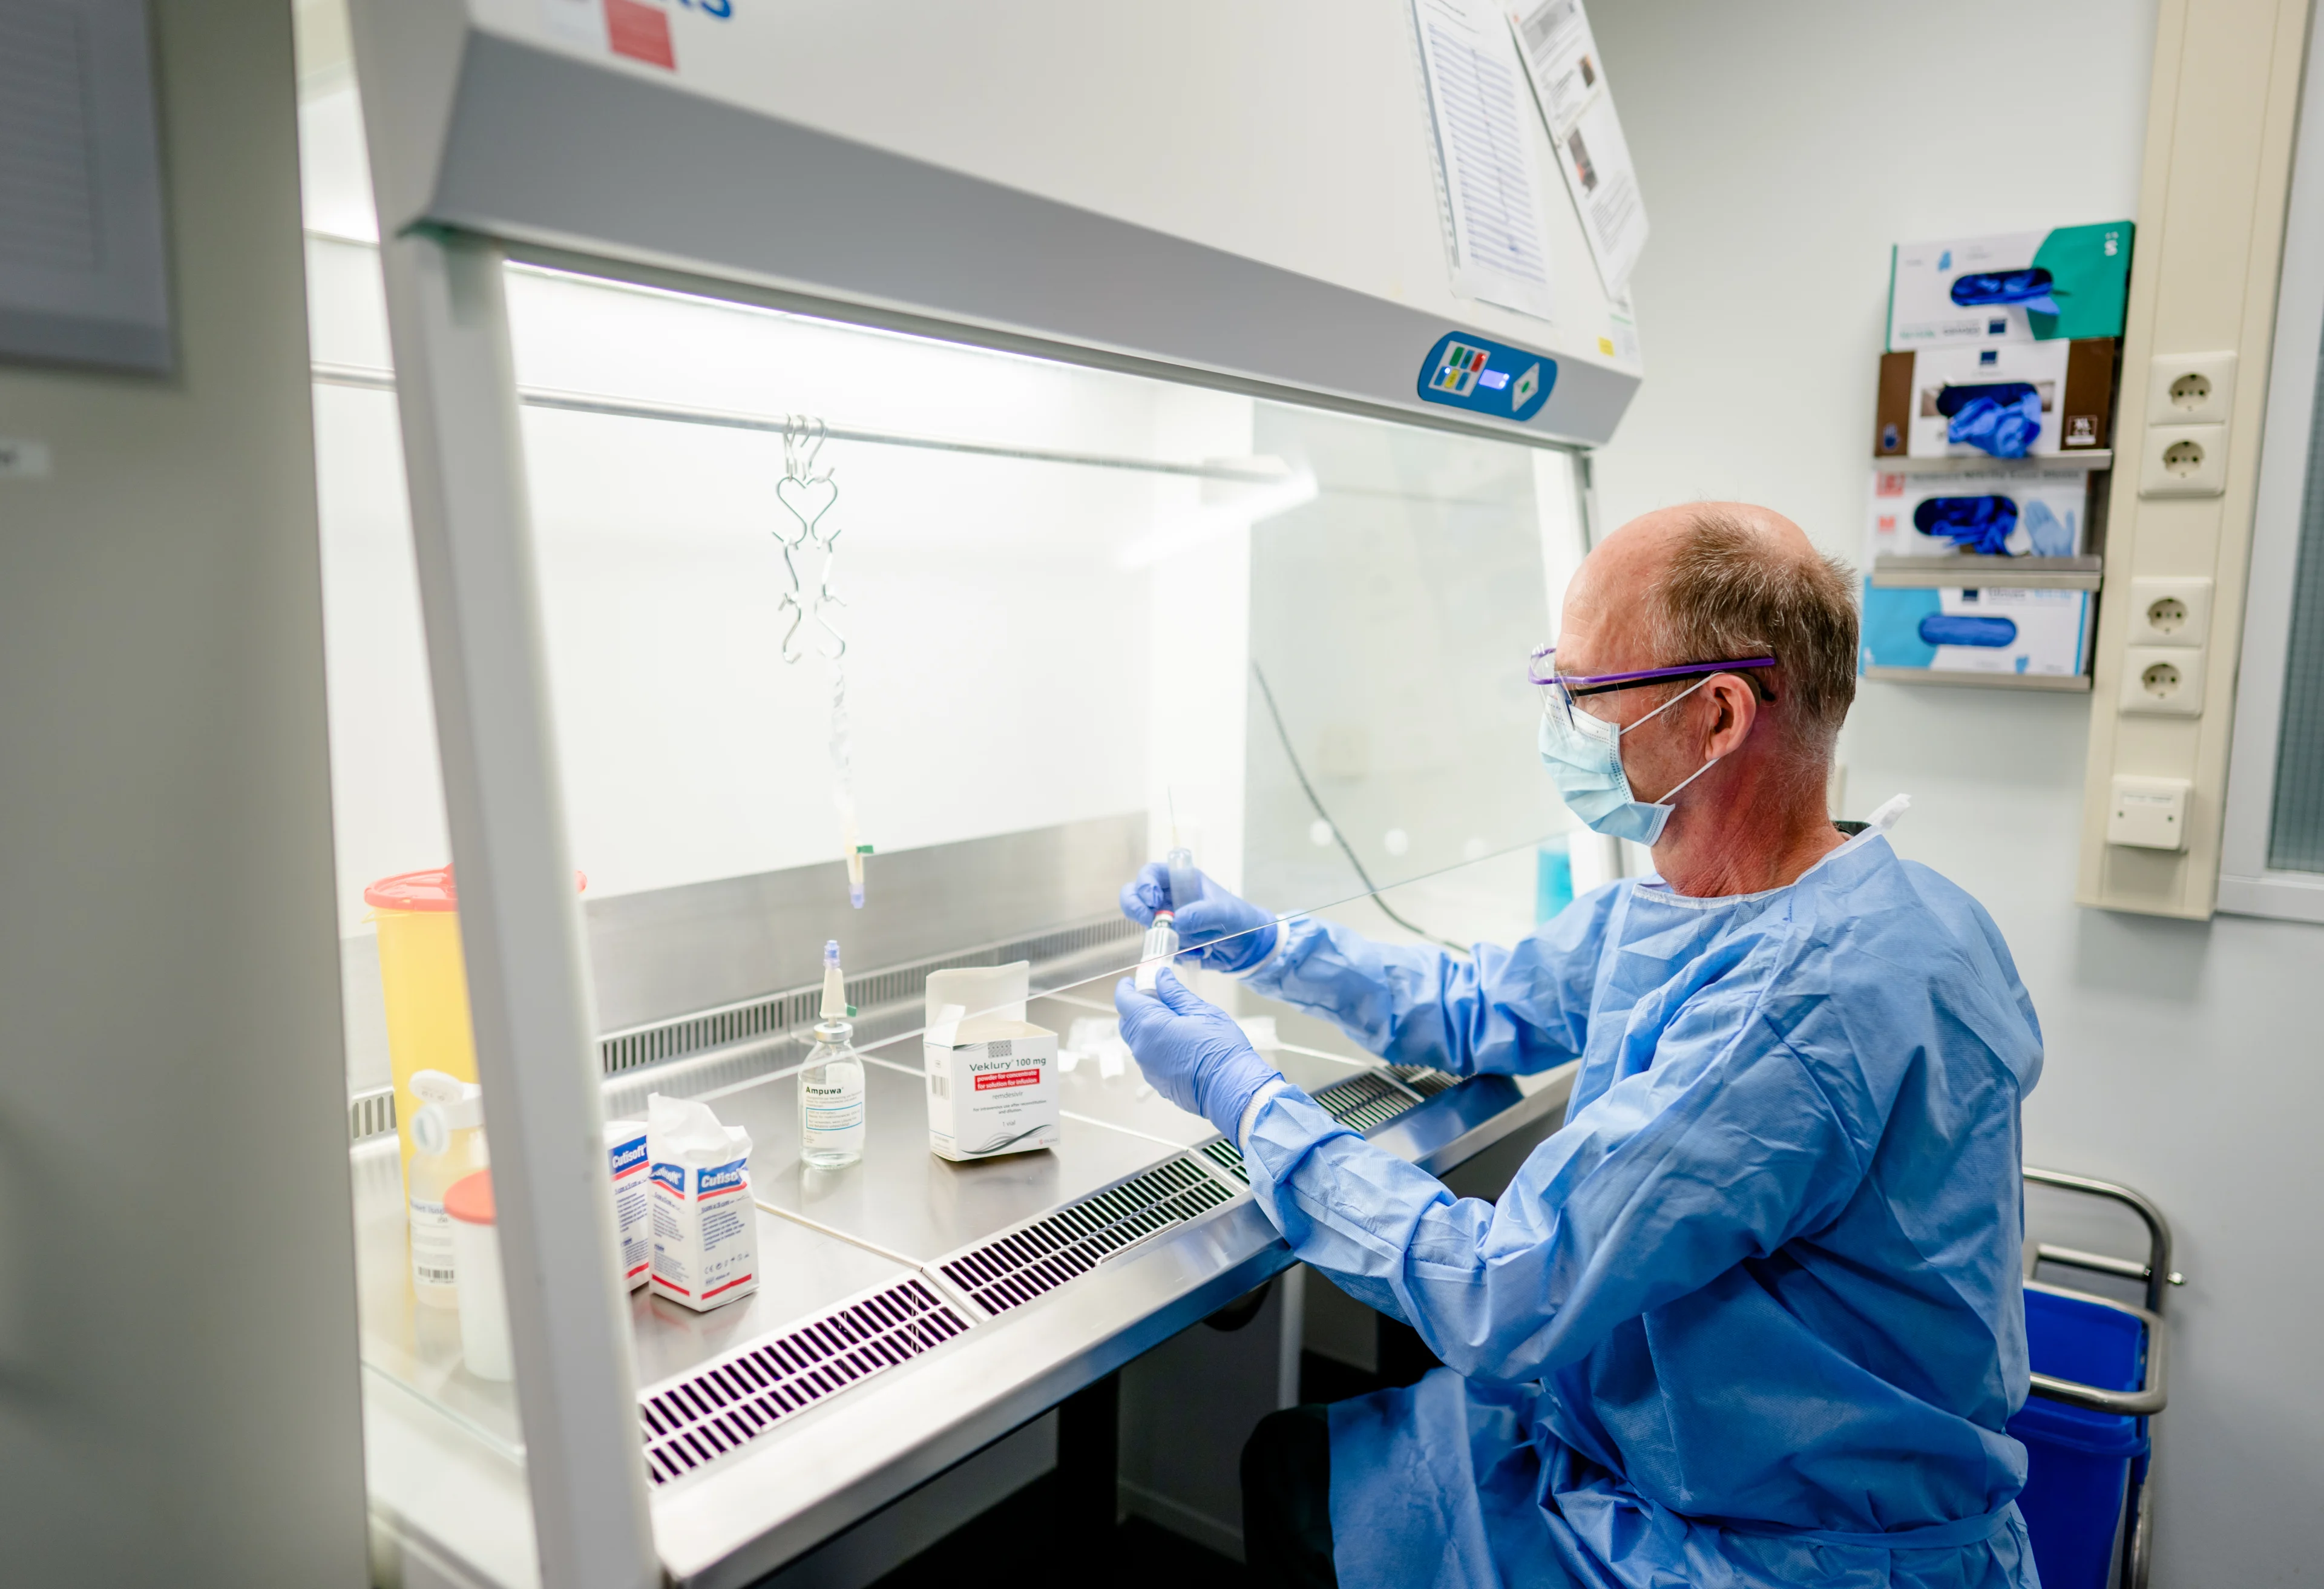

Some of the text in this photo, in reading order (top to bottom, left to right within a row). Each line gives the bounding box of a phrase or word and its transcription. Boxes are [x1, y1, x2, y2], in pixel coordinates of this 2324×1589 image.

[969, 1058, 1046, 1071] Veklury 100 mg
[806, 1086, 842, 1096] Ampuwa
[992, 1091, 1024, 1099] remdesivir
[612, 1144, 645, 1169] Cutisoft
